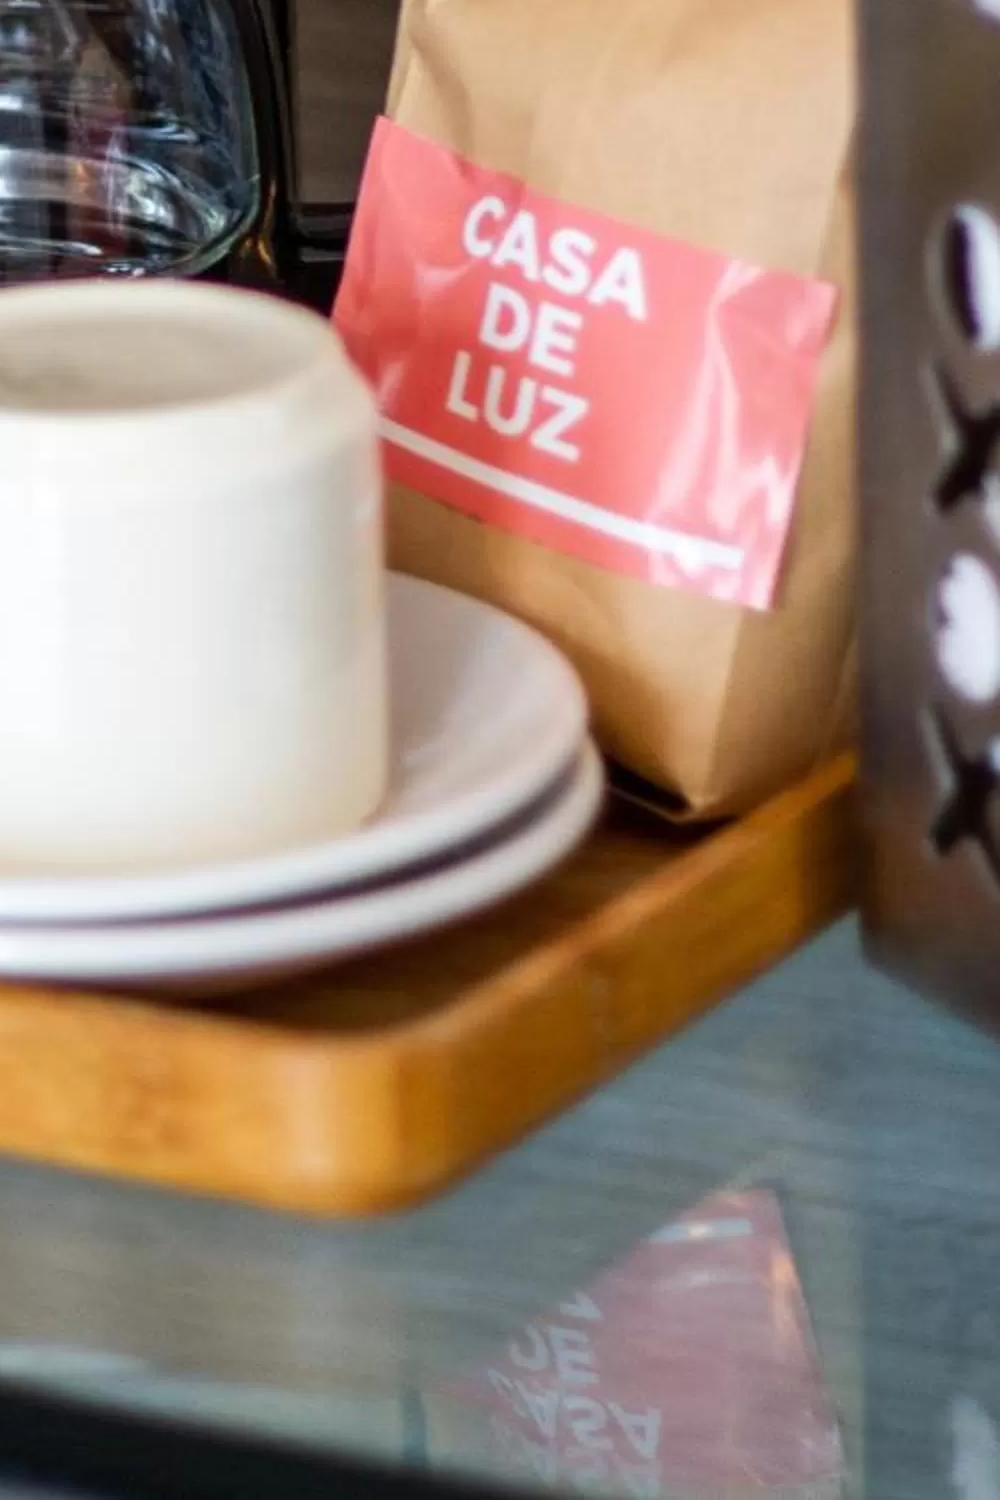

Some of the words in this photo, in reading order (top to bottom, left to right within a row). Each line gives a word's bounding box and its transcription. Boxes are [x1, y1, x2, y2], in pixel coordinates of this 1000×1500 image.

[462, 195, 648, 321] CASA
[479, 283, 583, 376] DE
[446, 351, 588, 463] LUZ
